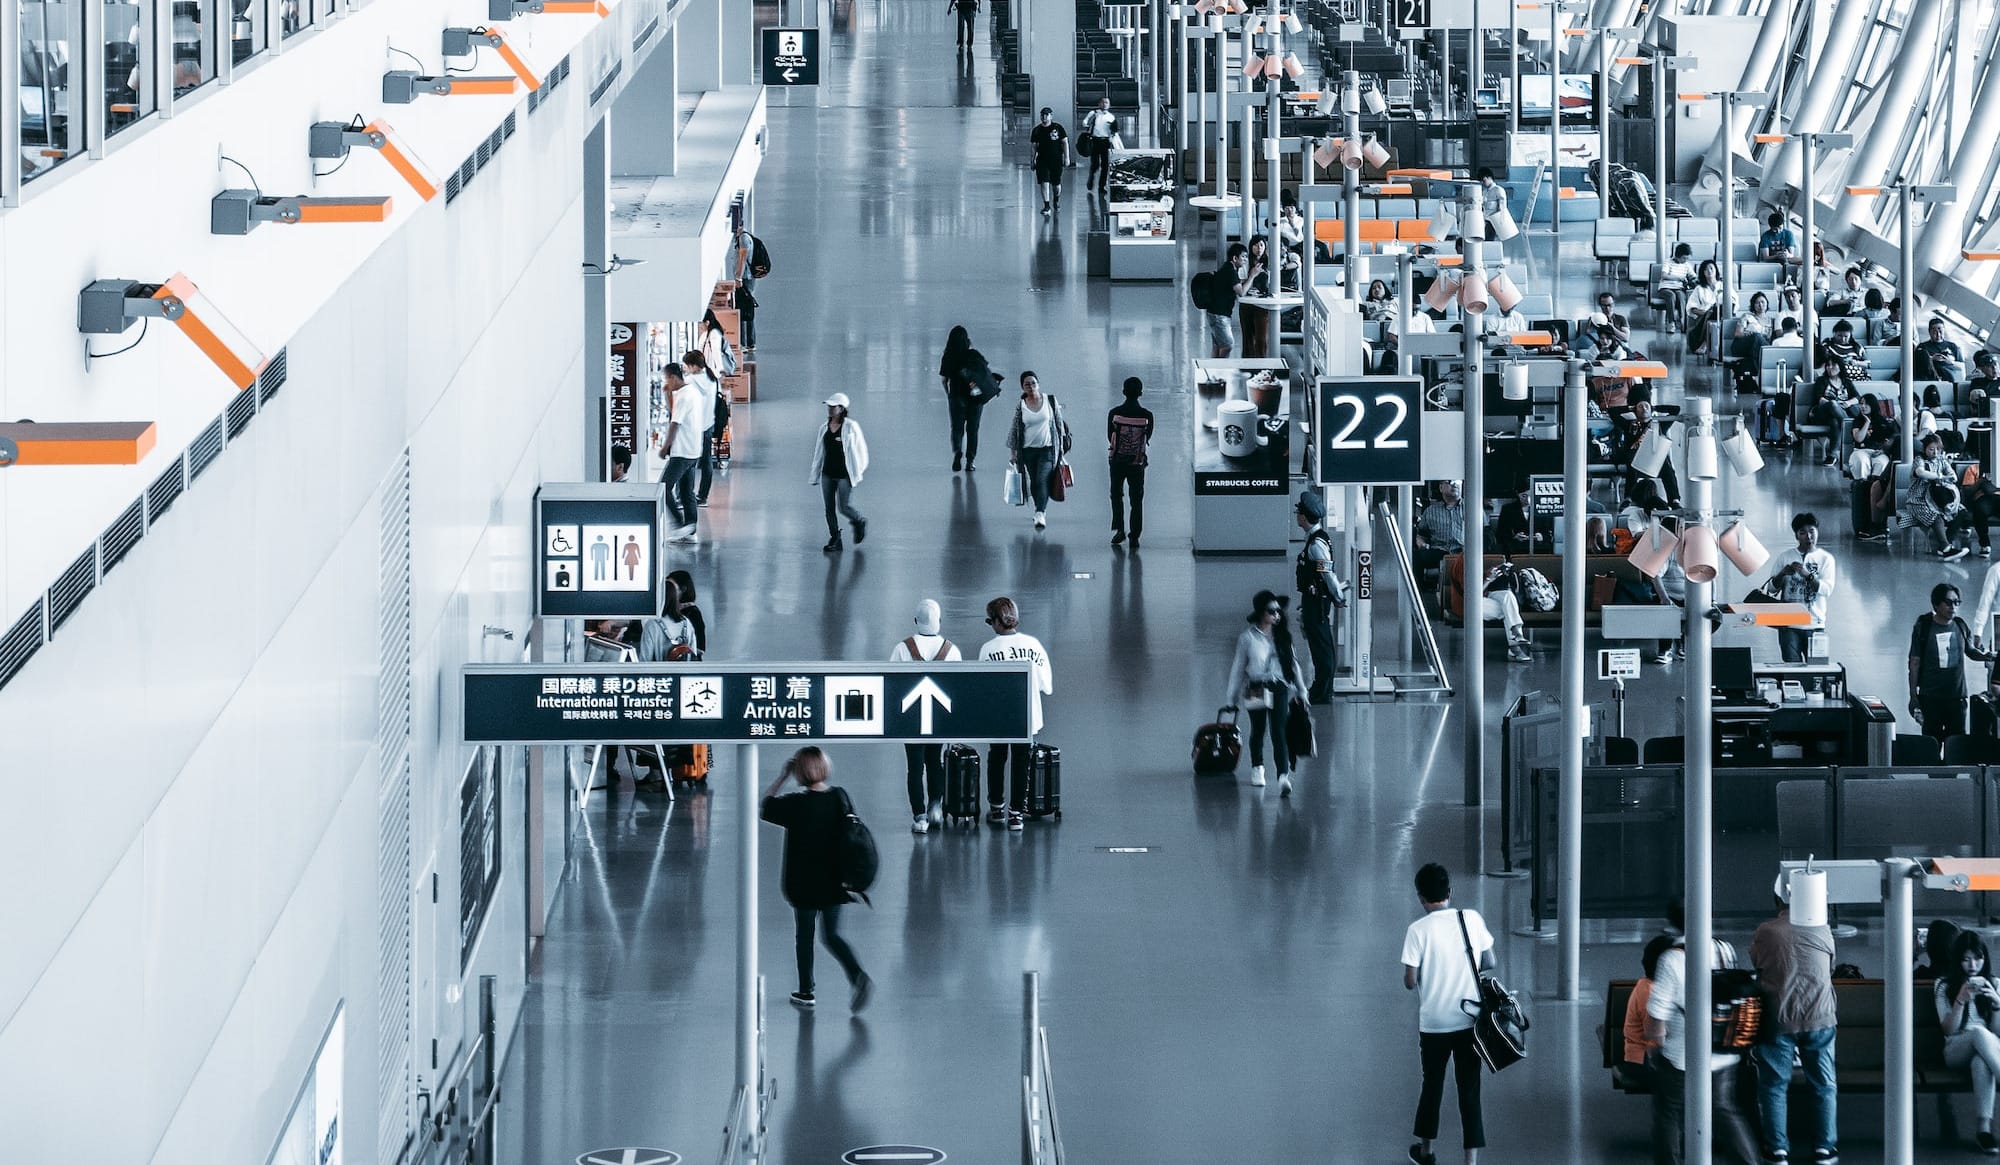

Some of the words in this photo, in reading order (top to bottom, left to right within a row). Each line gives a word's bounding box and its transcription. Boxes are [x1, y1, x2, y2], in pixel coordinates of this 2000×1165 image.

[1404, 0, 1425, 24] 21
[1332, 394, 1409, 449] 22
[1361, 567, 1370, 598] AED
[542, 677, 597, 694] 国際線
[602, 677, 673, 694] 乗り継ぎ
[536, 695, 618, 708] International
[621, 695, 673, 708] Transfer
[743, 702, 811, 719] Arrivals
[750, 723, 776, 736] 到达
[784, 723, 811, 736] 도착
